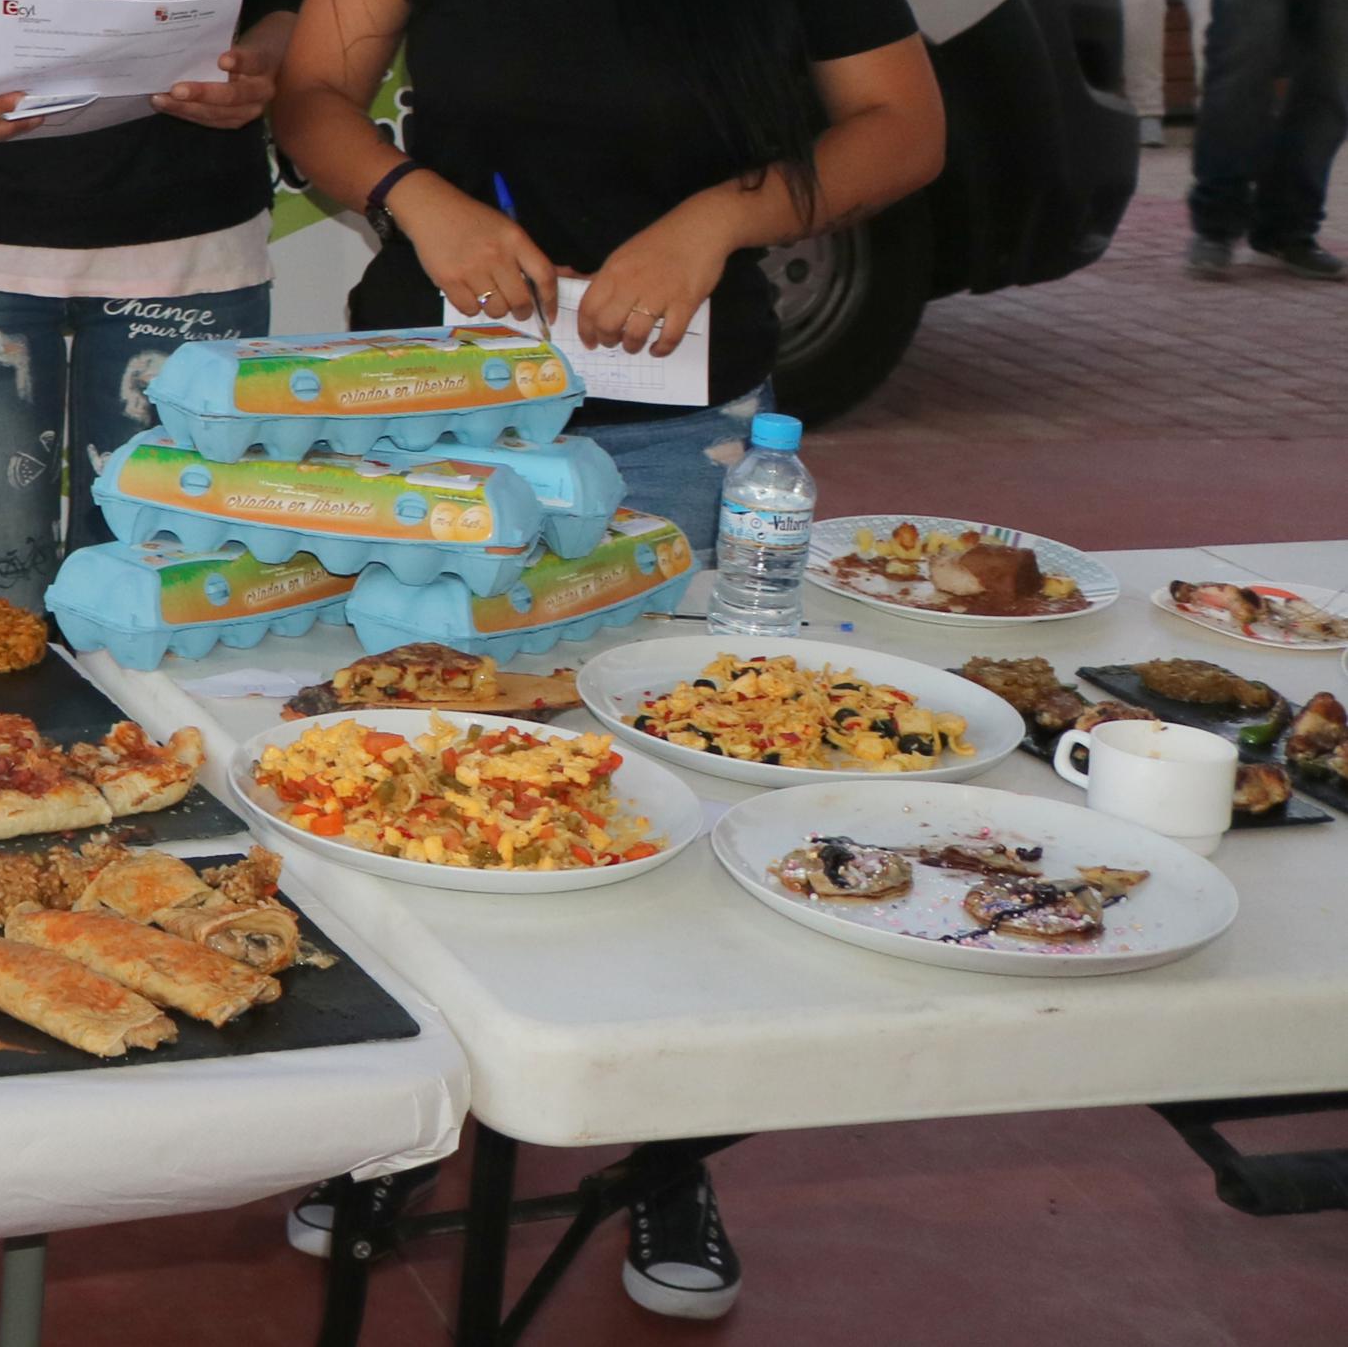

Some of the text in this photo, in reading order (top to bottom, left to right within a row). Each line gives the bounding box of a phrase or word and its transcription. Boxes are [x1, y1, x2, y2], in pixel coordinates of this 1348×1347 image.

[103, 298, 216, 332] Change
[128, 321, 178, 339] your
[339, 375, 465, 405] criadas en libertad
[226, 494, 374, 518] criadas en libertad
